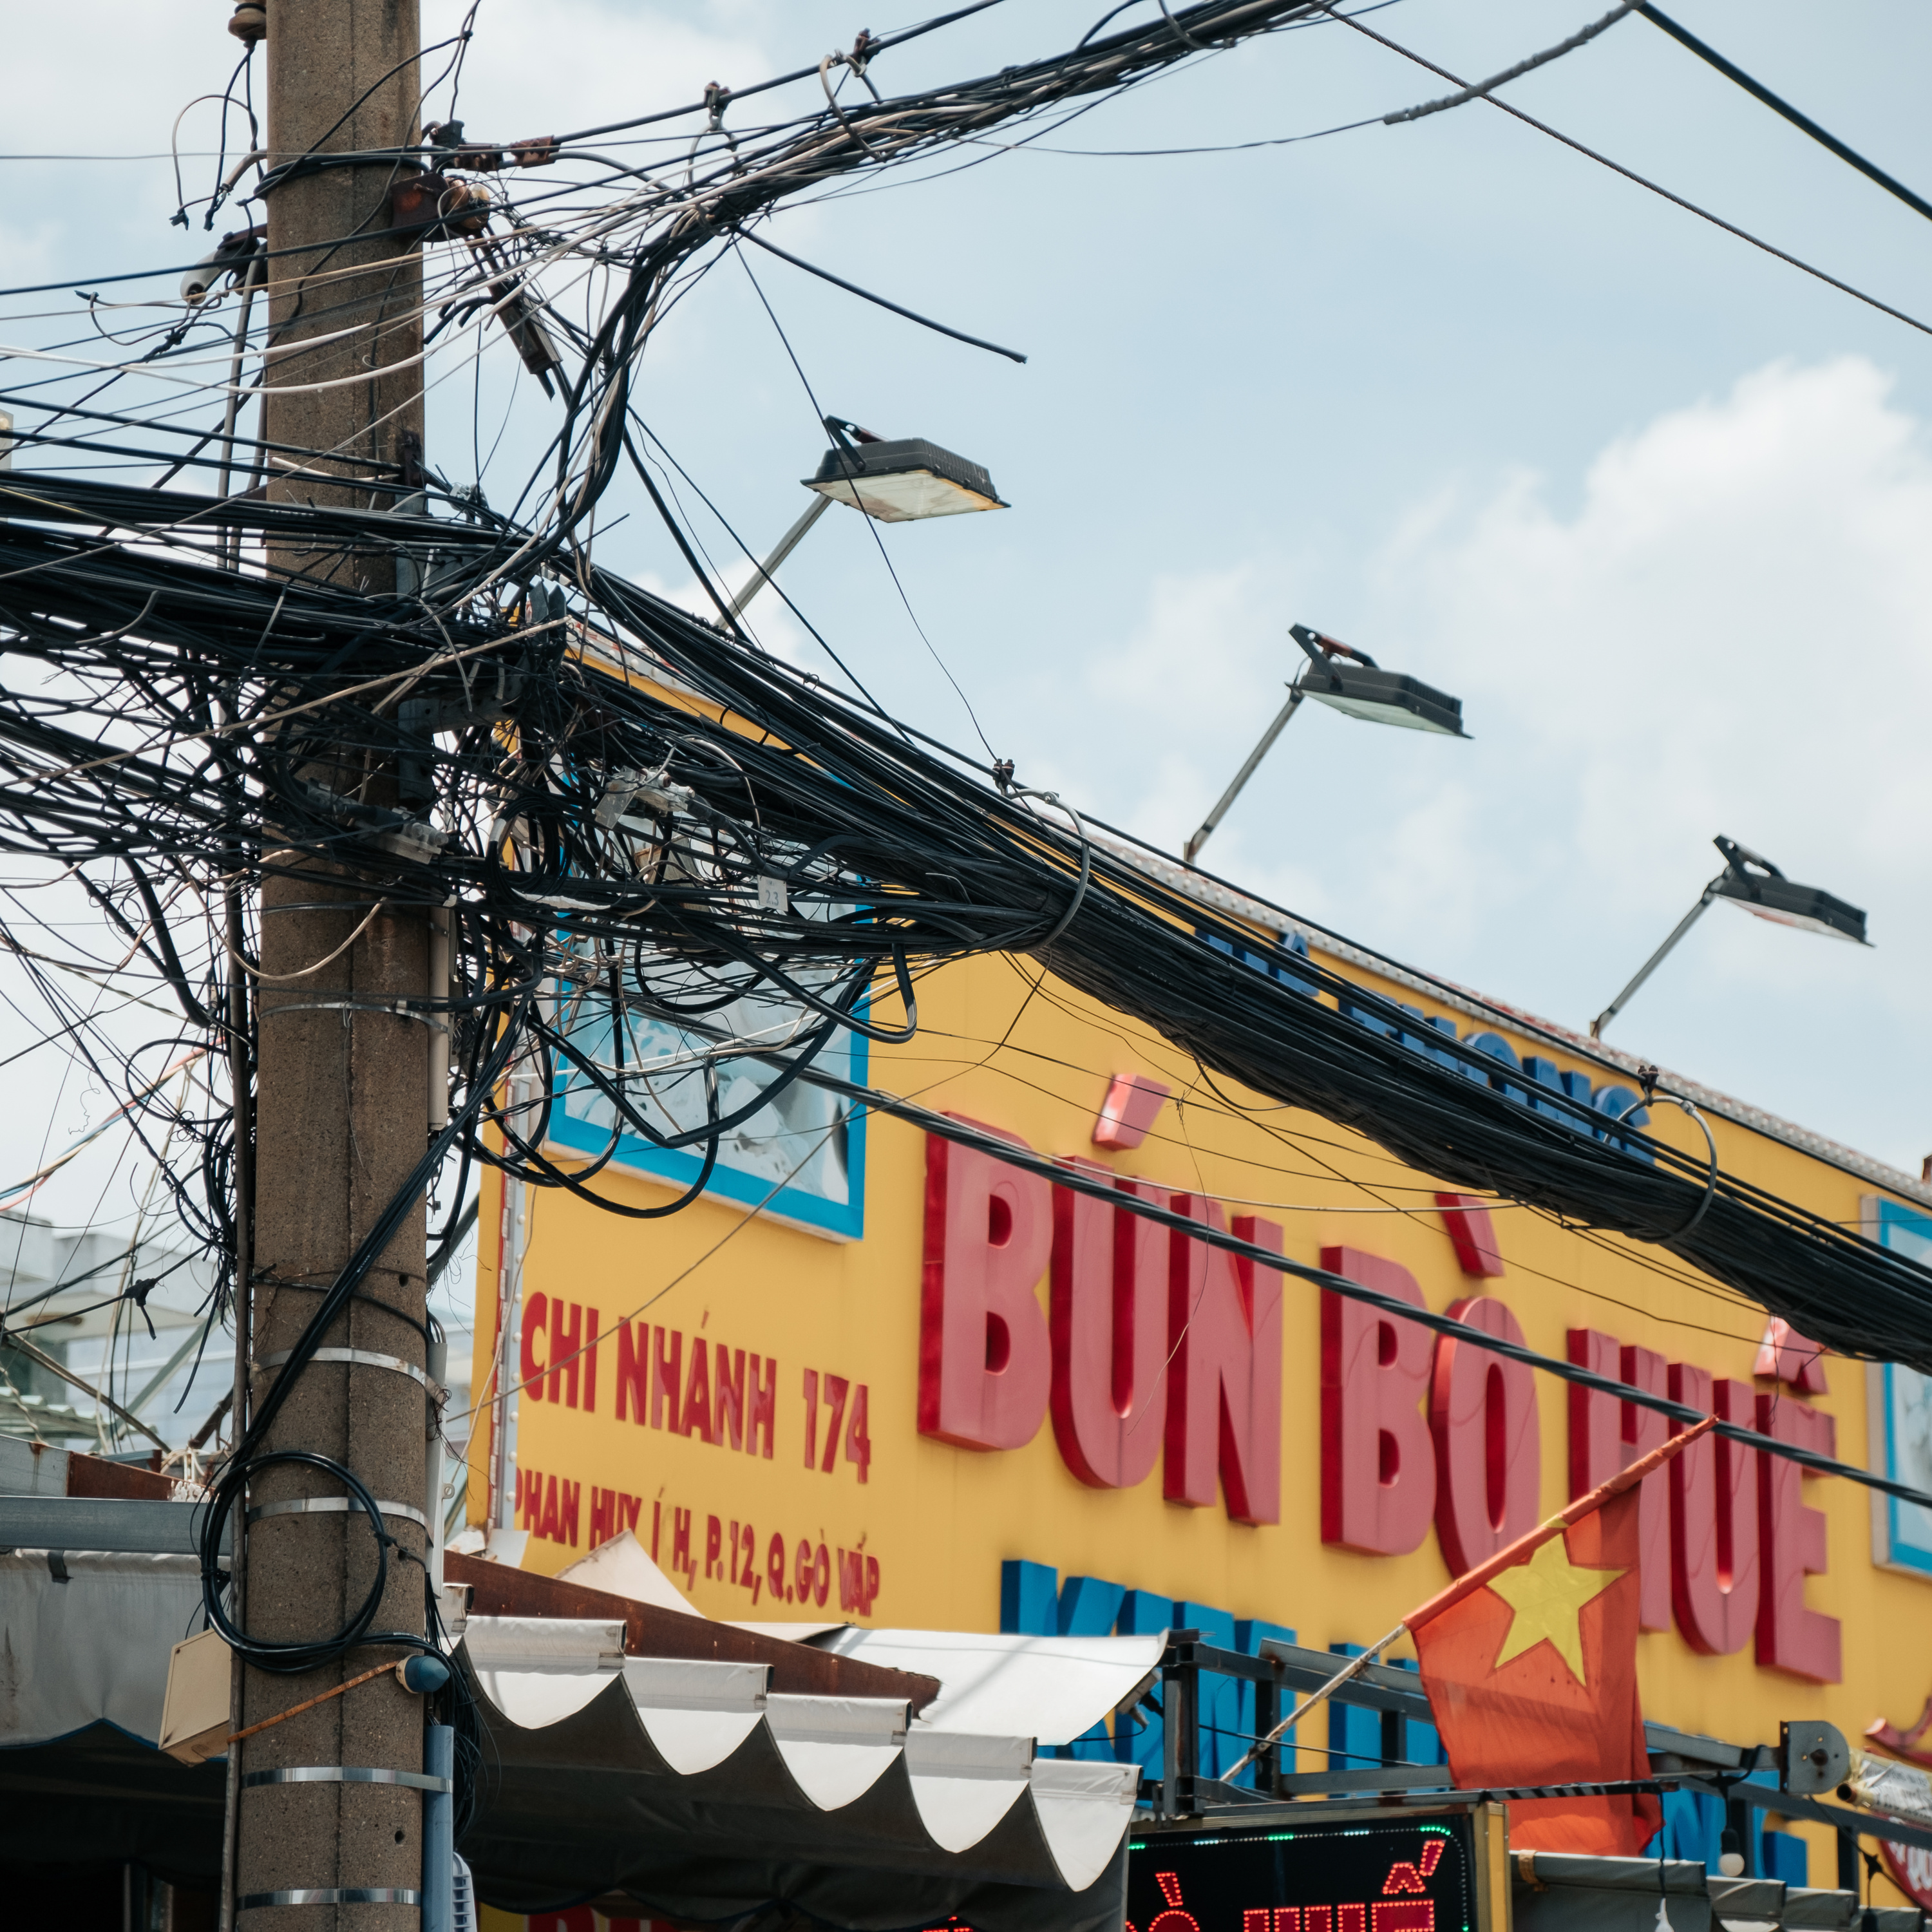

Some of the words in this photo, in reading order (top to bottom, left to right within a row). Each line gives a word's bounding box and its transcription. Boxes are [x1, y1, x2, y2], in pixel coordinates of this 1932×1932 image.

[520, 1291, 599, 1414] CHI
[616, 1309, 777, 1460] NHÁNH
[803, 1368, 871, 1484] 174
[918, 1074, 1283, 1527] BÚN
[1320, 1191, 1540, 1582] BÒ
